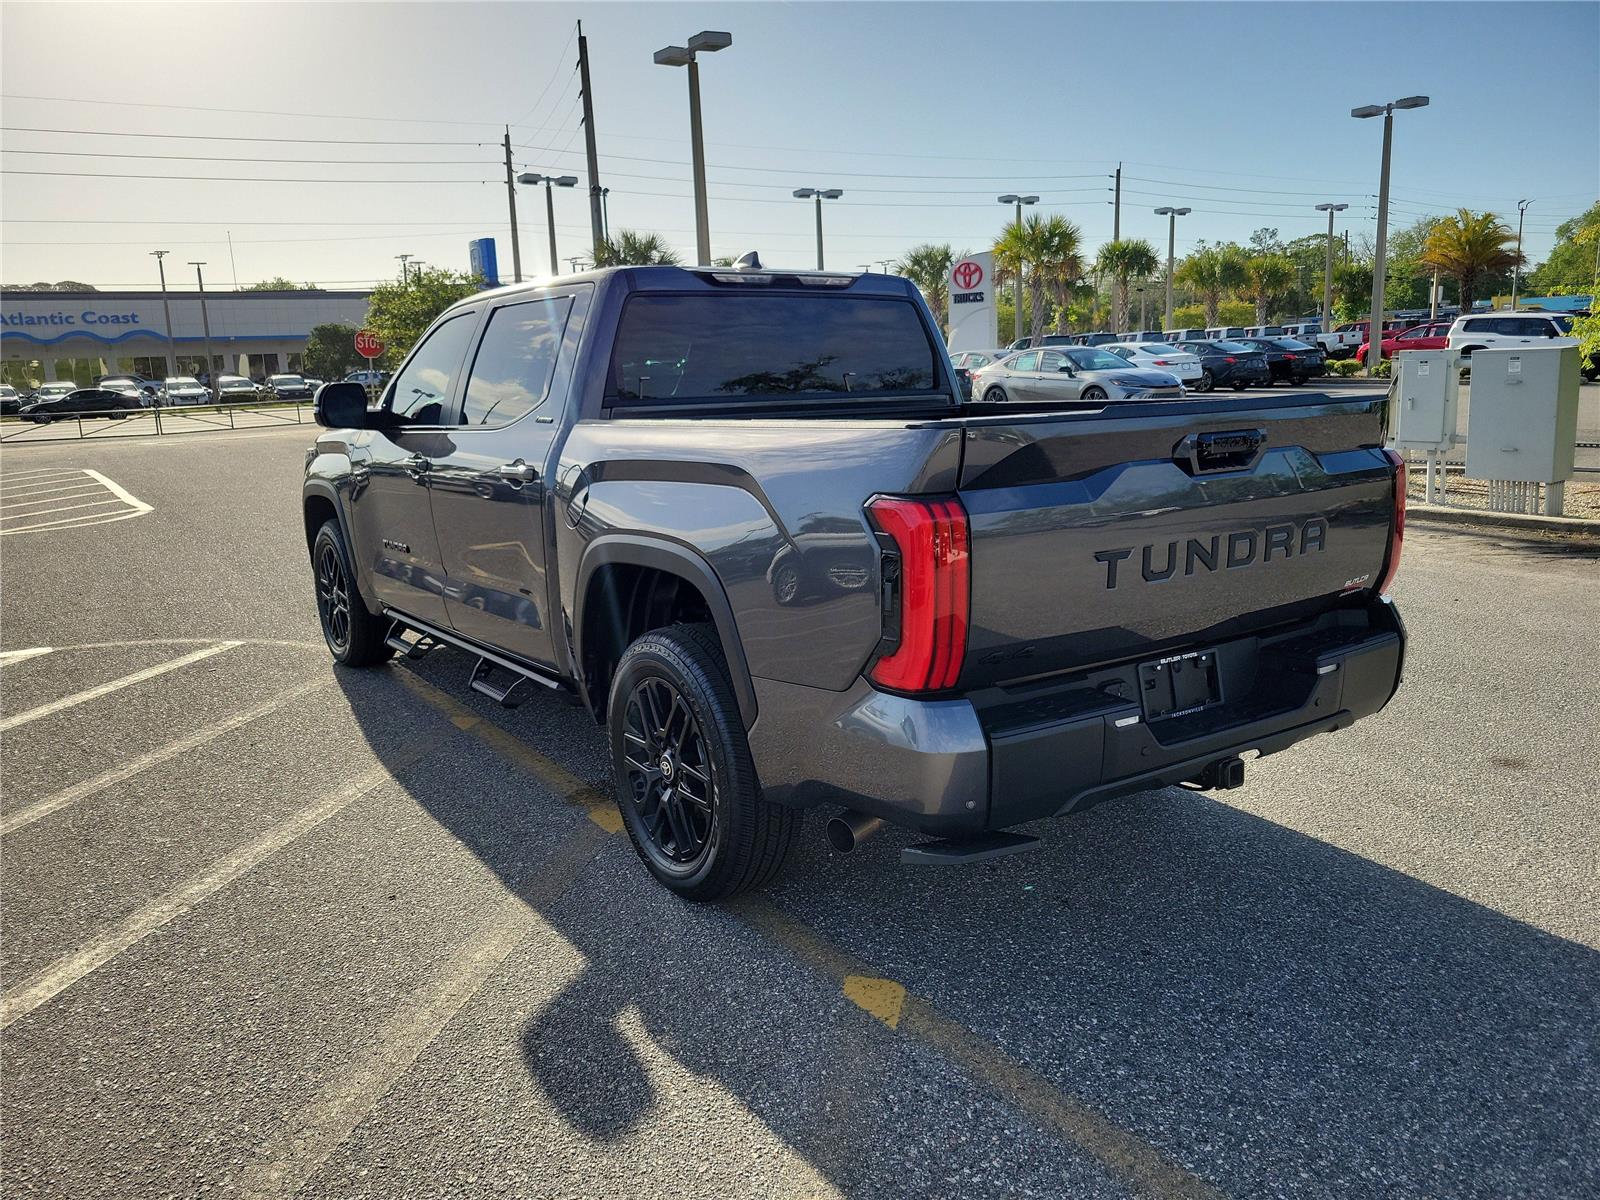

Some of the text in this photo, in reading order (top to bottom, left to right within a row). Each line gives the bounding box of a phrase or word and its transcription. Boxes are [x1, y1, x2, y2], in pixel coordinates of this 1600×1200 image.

[952, 292, 984, 304] TRUCKS
[81, 311, 140, 324] Coast
[1093, 516, 1329, 590] TUNDRA
[1160, 652, 1199, 665] BUTLER TOYOTA
[1171, 705, 1204, 718] JACKSONVILLE
